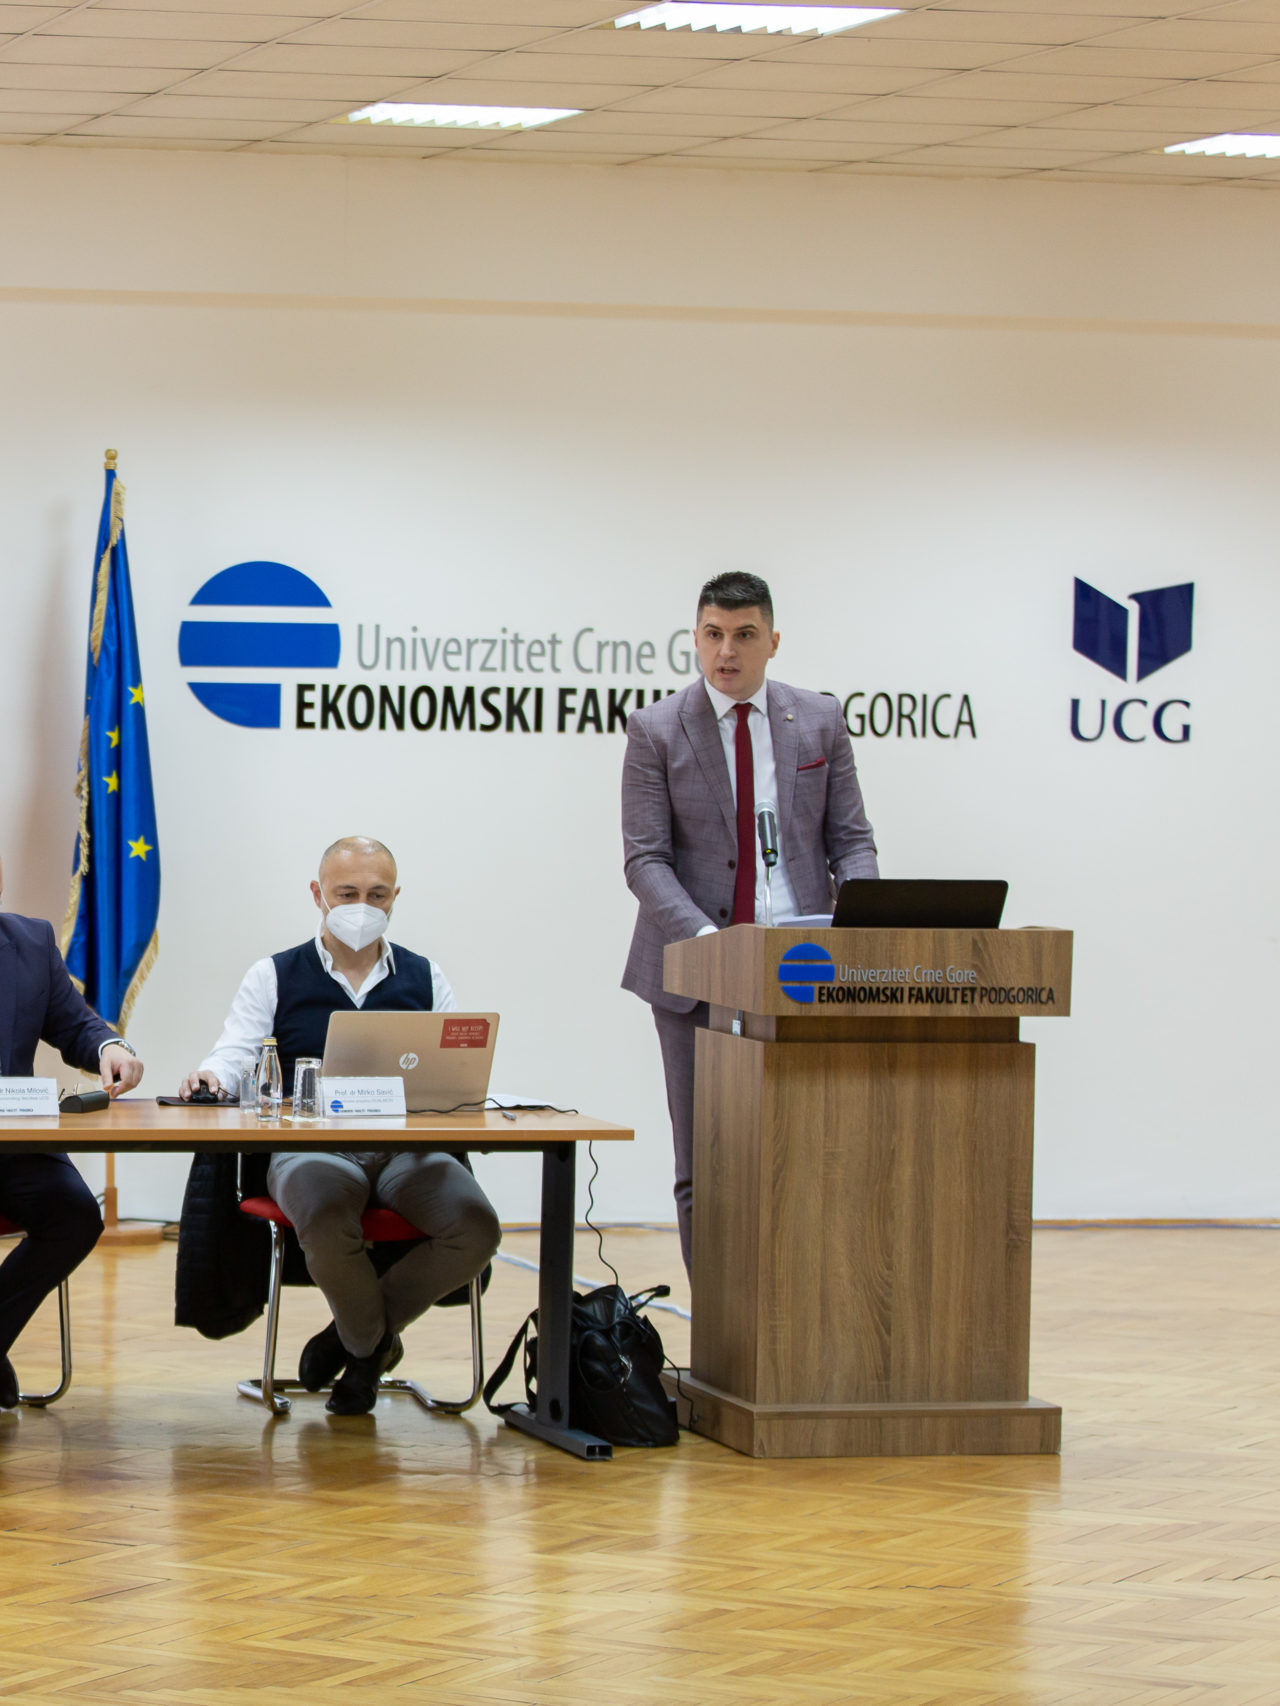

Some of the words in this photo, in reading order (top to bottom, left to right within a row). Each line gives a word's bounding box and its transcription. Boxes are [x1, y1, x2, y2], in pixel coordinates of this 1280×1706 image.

[358, 624, 562, 674] Univerzitet
[573, 627, 656, 675] Crne
[296, 684, 543, 733] EKONOMSKI
[1070, 698, 1191, 744] UCG
[839, 964, 911, 983] Univerzitet
[913, 964, 943, 983] Crne
[946, 964, 977, 984] Gore
[818, 986, 905, 1004] EKONOMSKI
[908, 986, 977, 1005] FAKULTET
[979, 986, 1055, 1005] PODGORICA
[402, 1053, 416, 1070] hp
